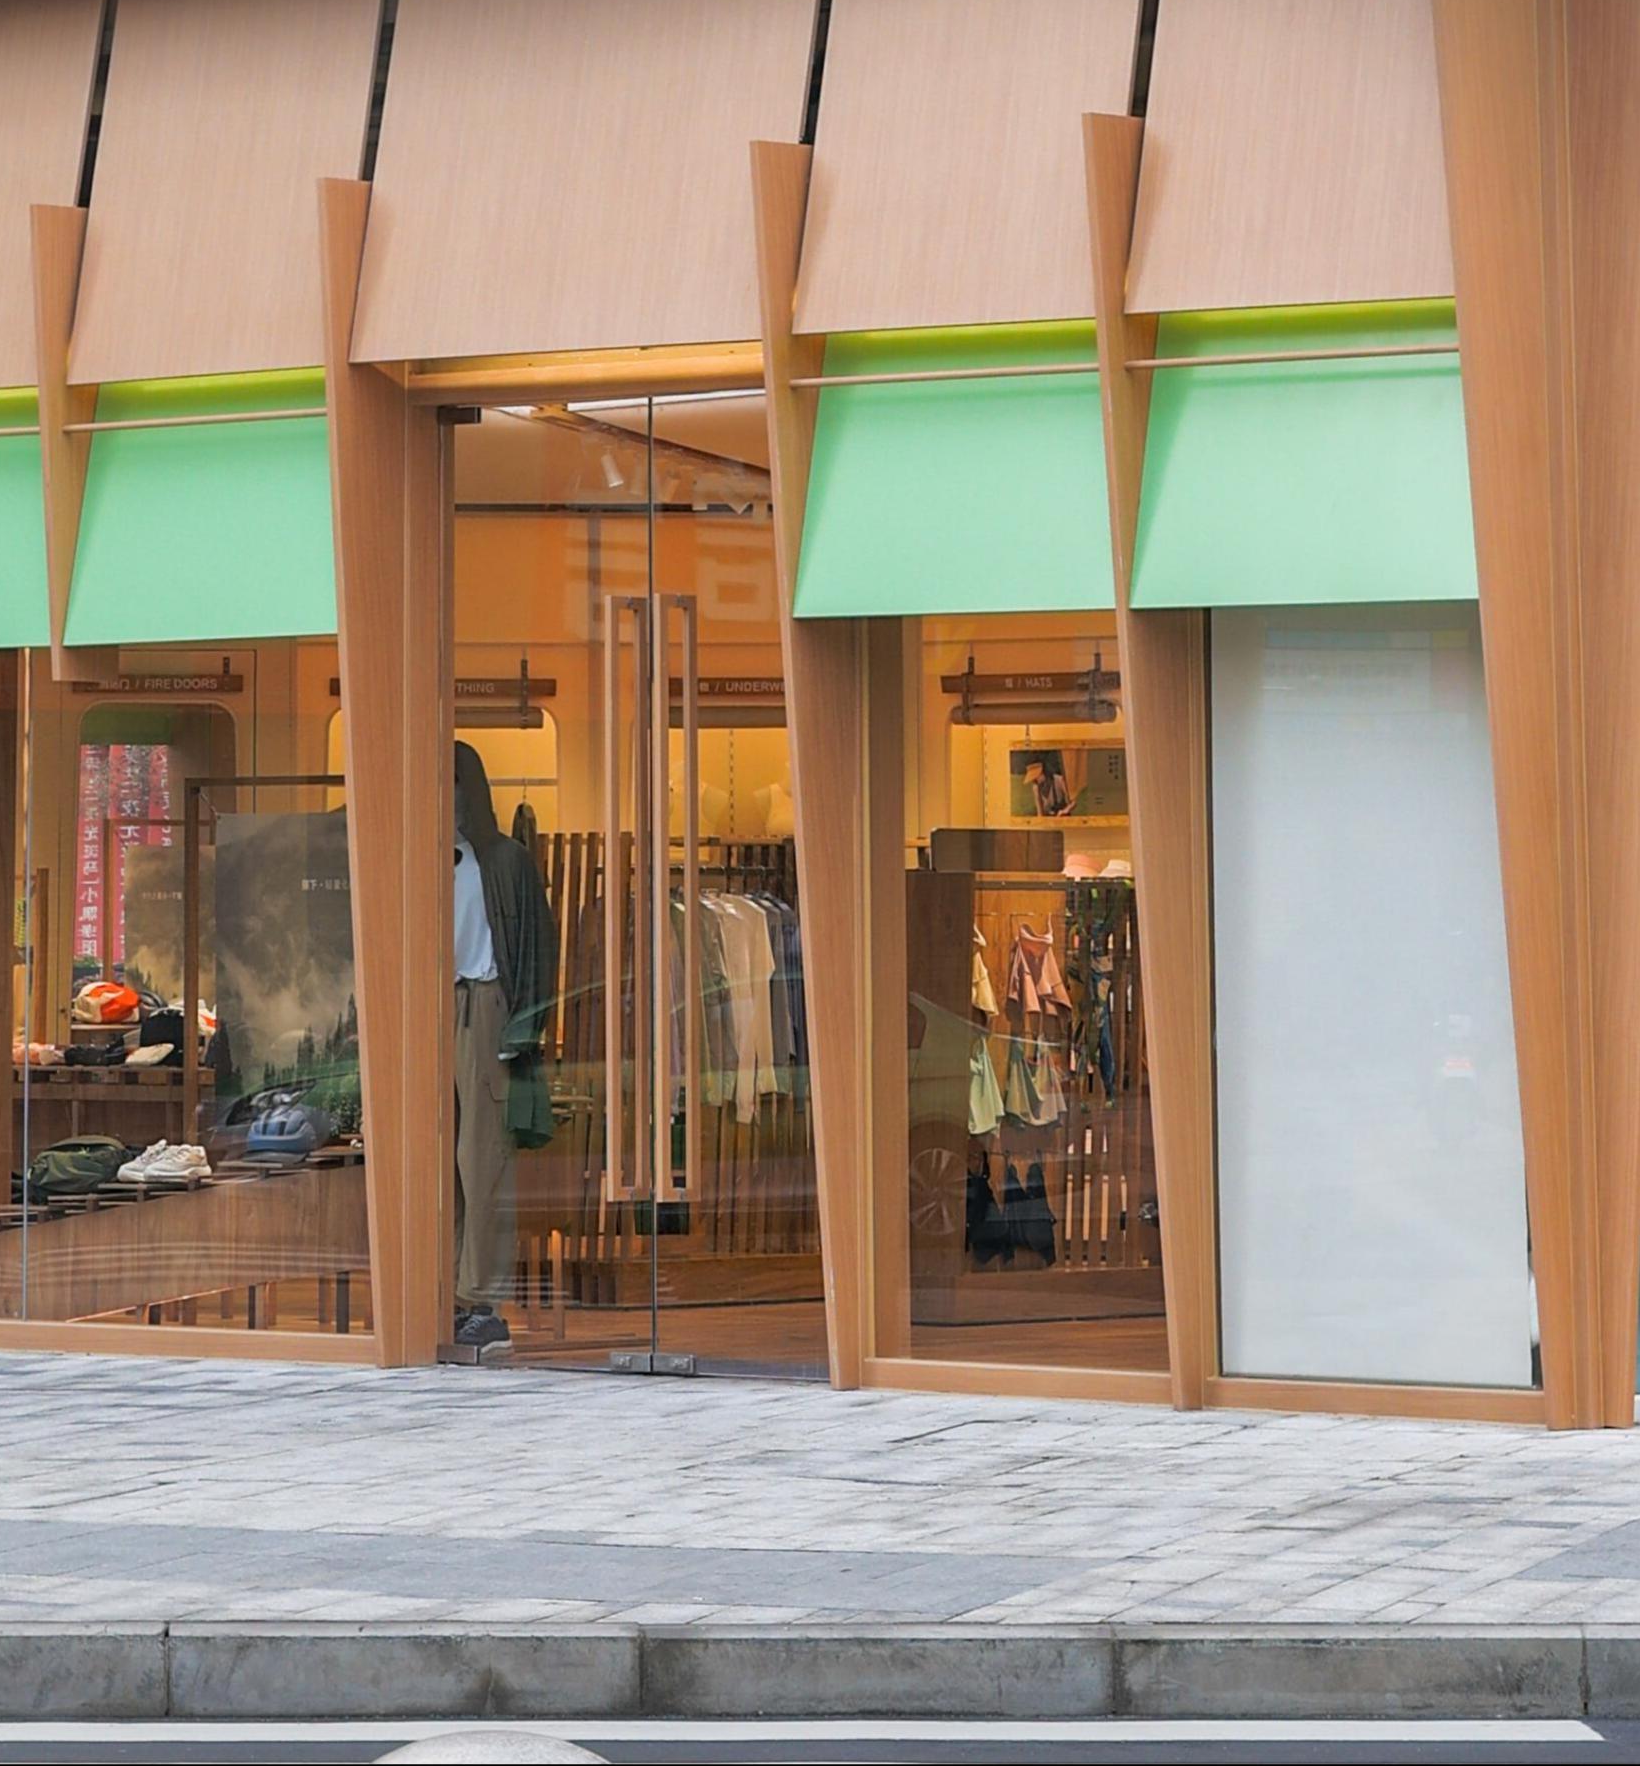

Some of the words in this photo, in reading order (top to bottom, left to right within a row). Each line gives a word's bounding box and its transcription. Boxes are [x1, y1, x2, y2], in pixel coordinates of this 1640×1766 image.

[144, 677, 171, 690] FIRE
[173, 677, 218, 690] DOORS
[456, 682, 495, 694] THING
[725, 681, 785, 693] UNDERW
[1025, 676, 1053, 689] HATS
